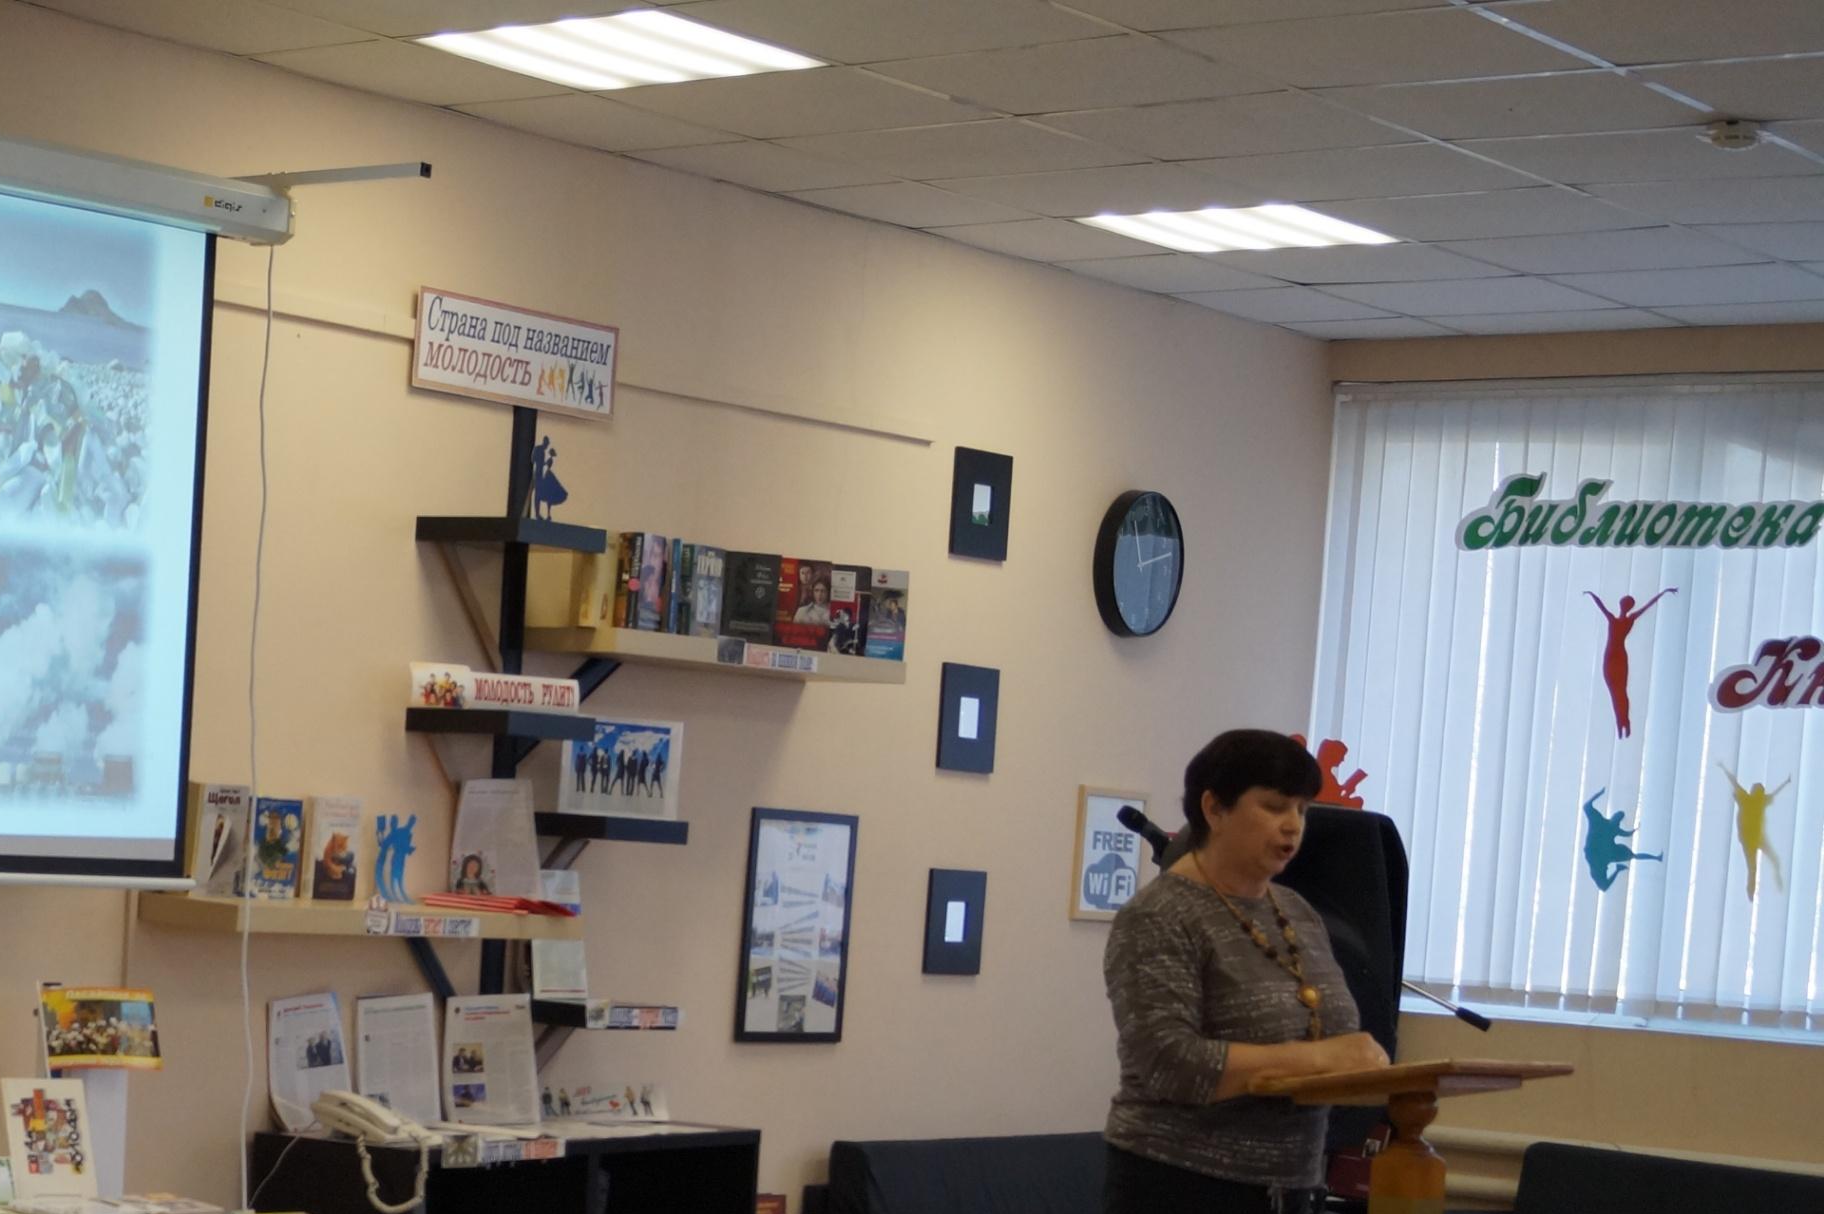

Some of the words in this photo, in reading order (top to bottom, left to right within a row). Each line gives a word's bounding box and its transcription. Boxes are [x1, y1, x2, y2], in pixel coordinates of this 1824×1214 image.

[427, 296, 488, 342] Страна
[491, 320, 523, 352] под
[523, 327, 613, 366] названием
[1462, 473, 1824, 549] Библиотека
[1093, 830, 1135, 852] FREE
